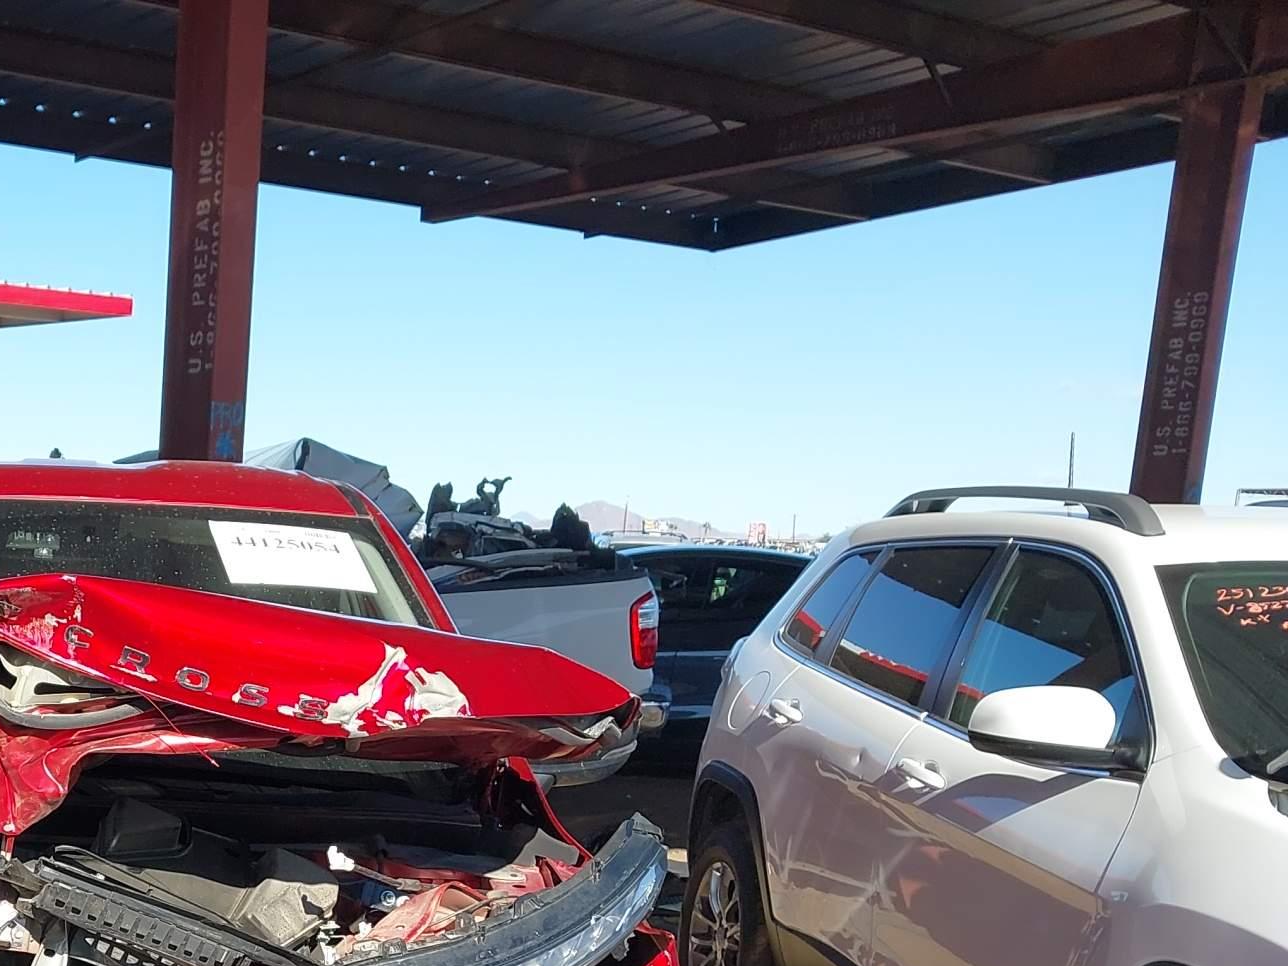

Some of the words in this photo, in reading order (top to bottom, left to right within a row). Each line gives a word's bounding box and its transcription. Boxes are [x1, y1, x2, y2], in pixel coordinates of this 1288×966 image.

[198, 131, 214, 185] INC.
[191, 198, 212, 307] PREFAB
[1171, 291, 1192, 328] INC.
[187, 321, 205, 374] U.S.
[1160, 336, 1184, 410] PREFAB
[1152, 421, 1173, 456] U.S.
[63, 623, 329, 721] CROSS
